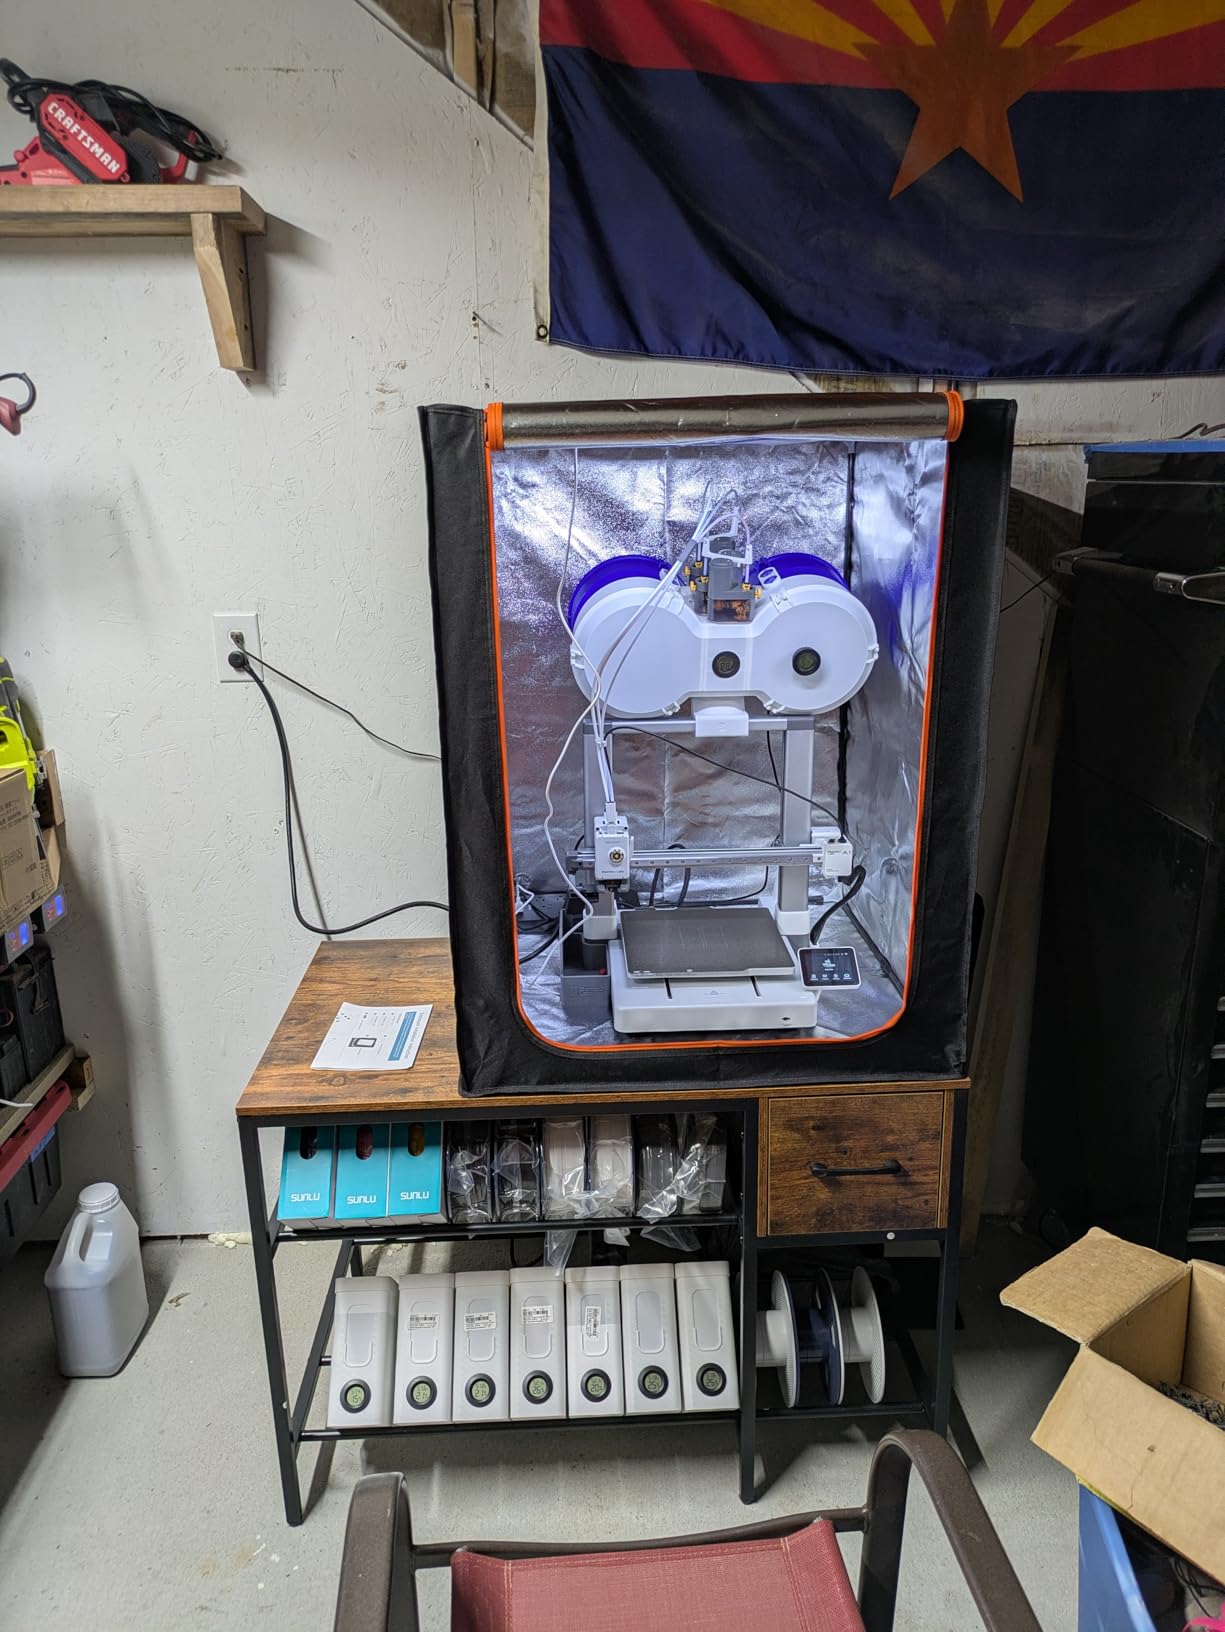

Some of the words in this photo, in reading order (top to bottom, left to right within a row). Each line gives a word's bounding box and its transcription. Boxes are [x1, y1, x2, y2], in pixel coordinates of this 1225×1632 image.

[48, 102, 120, 174] CRAFTSMAN
[290, 1192, 320, 1202] SUNLU
[347, 1195, 376, 1205] SUNLU
[400, 1191, 430, 1201] SUNLU
